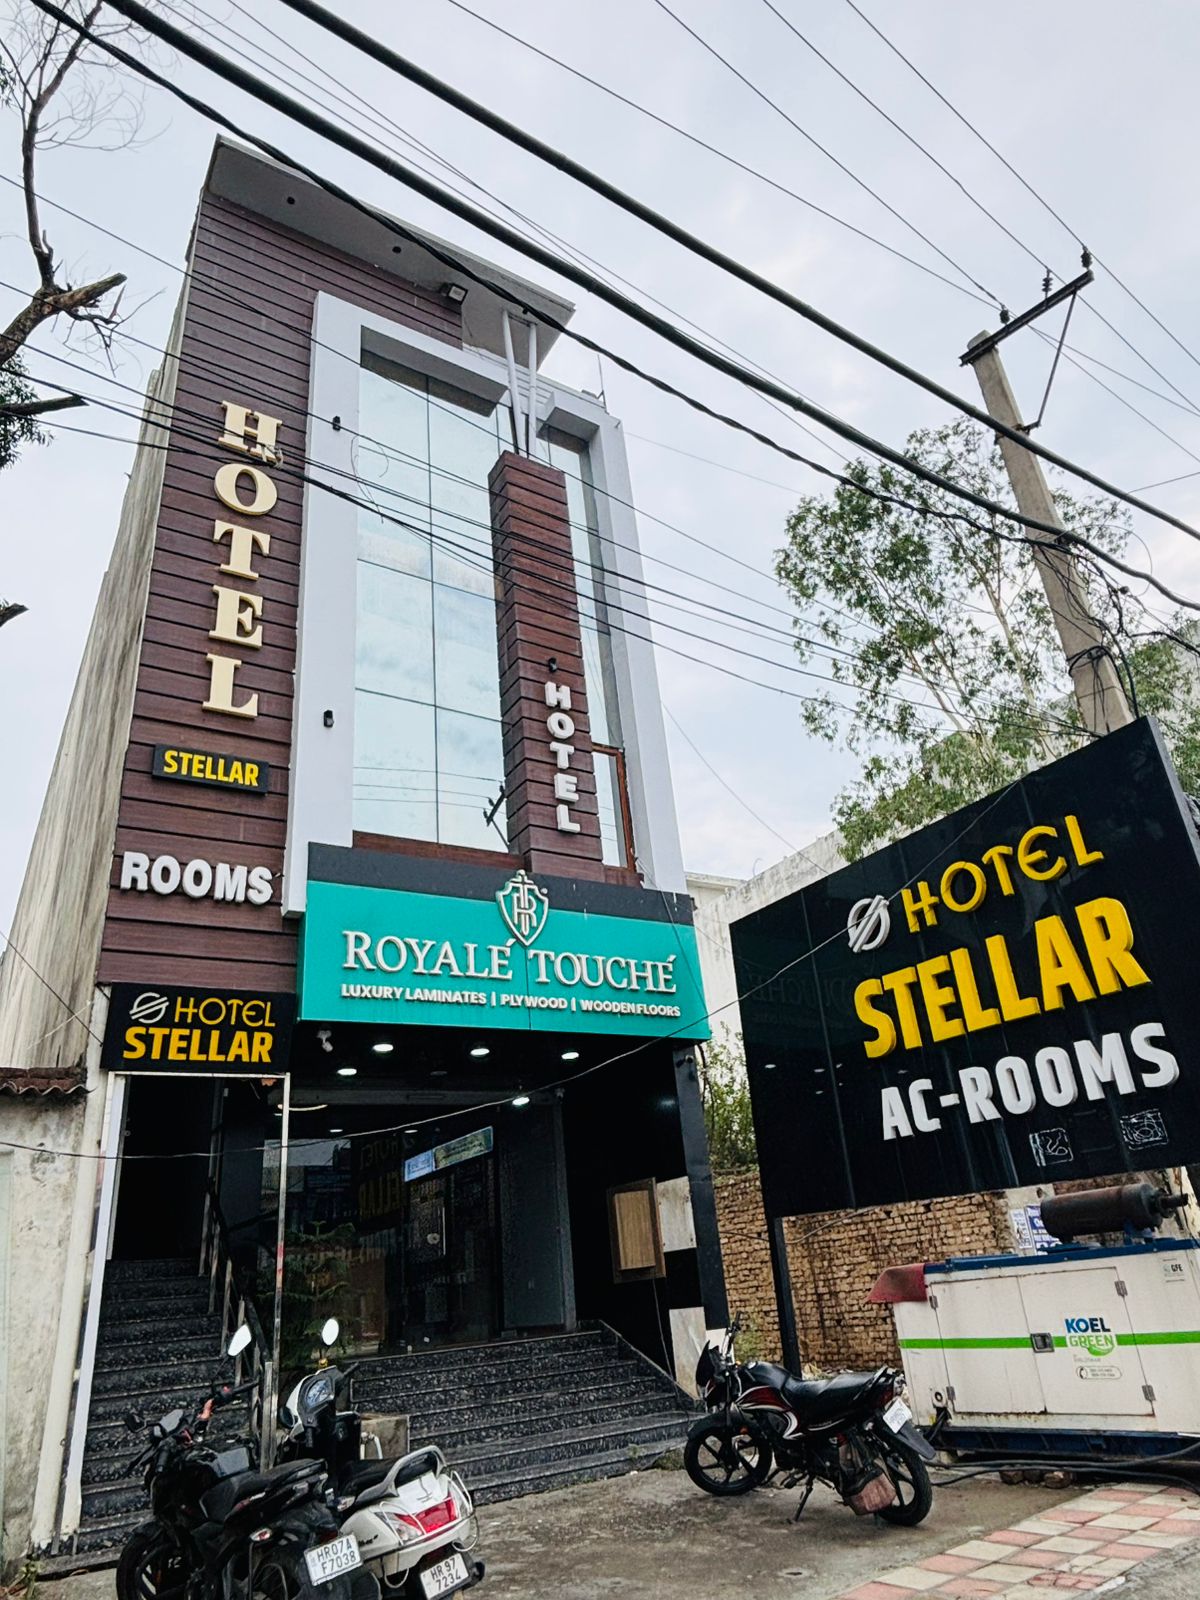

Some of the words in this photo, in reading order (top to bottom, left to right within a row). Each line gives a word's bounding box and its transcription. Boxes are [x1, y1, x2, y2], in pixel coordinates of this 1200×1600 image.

[202, 400, 283, 718] HOTEL
[163, 750, 260, 788] STELLAR
[544, 681, 581, 833] HOTEL
[120, 851, 273, 905] ROOMS
[901, 815, 1105, 933] HOTEL
[342, 931, 517, 980] ROYALÉ
[528, 949, 676, 993] TOUCHÉ
[854, 896, 1150, 1058] STELLAR
[174, 996, 276, 1027] HOTEL
[341, 984, 403, 1000] LUXURY
[405, 988, 487, 1005] LAMINATES
[501, 994, 568, 1010] PLYWOOD
[123, 1026, 274, 1063] STELLAR
[881, 1022, 1179, 1141] AC-ROOMS
[1065, 1317, 1111, 1334] KOEL
[1069, 1335, 1114, 1348] GREEN
[321, 1551, 357, 1574] F7038
[435, 1572, 462, 1591] 7234
